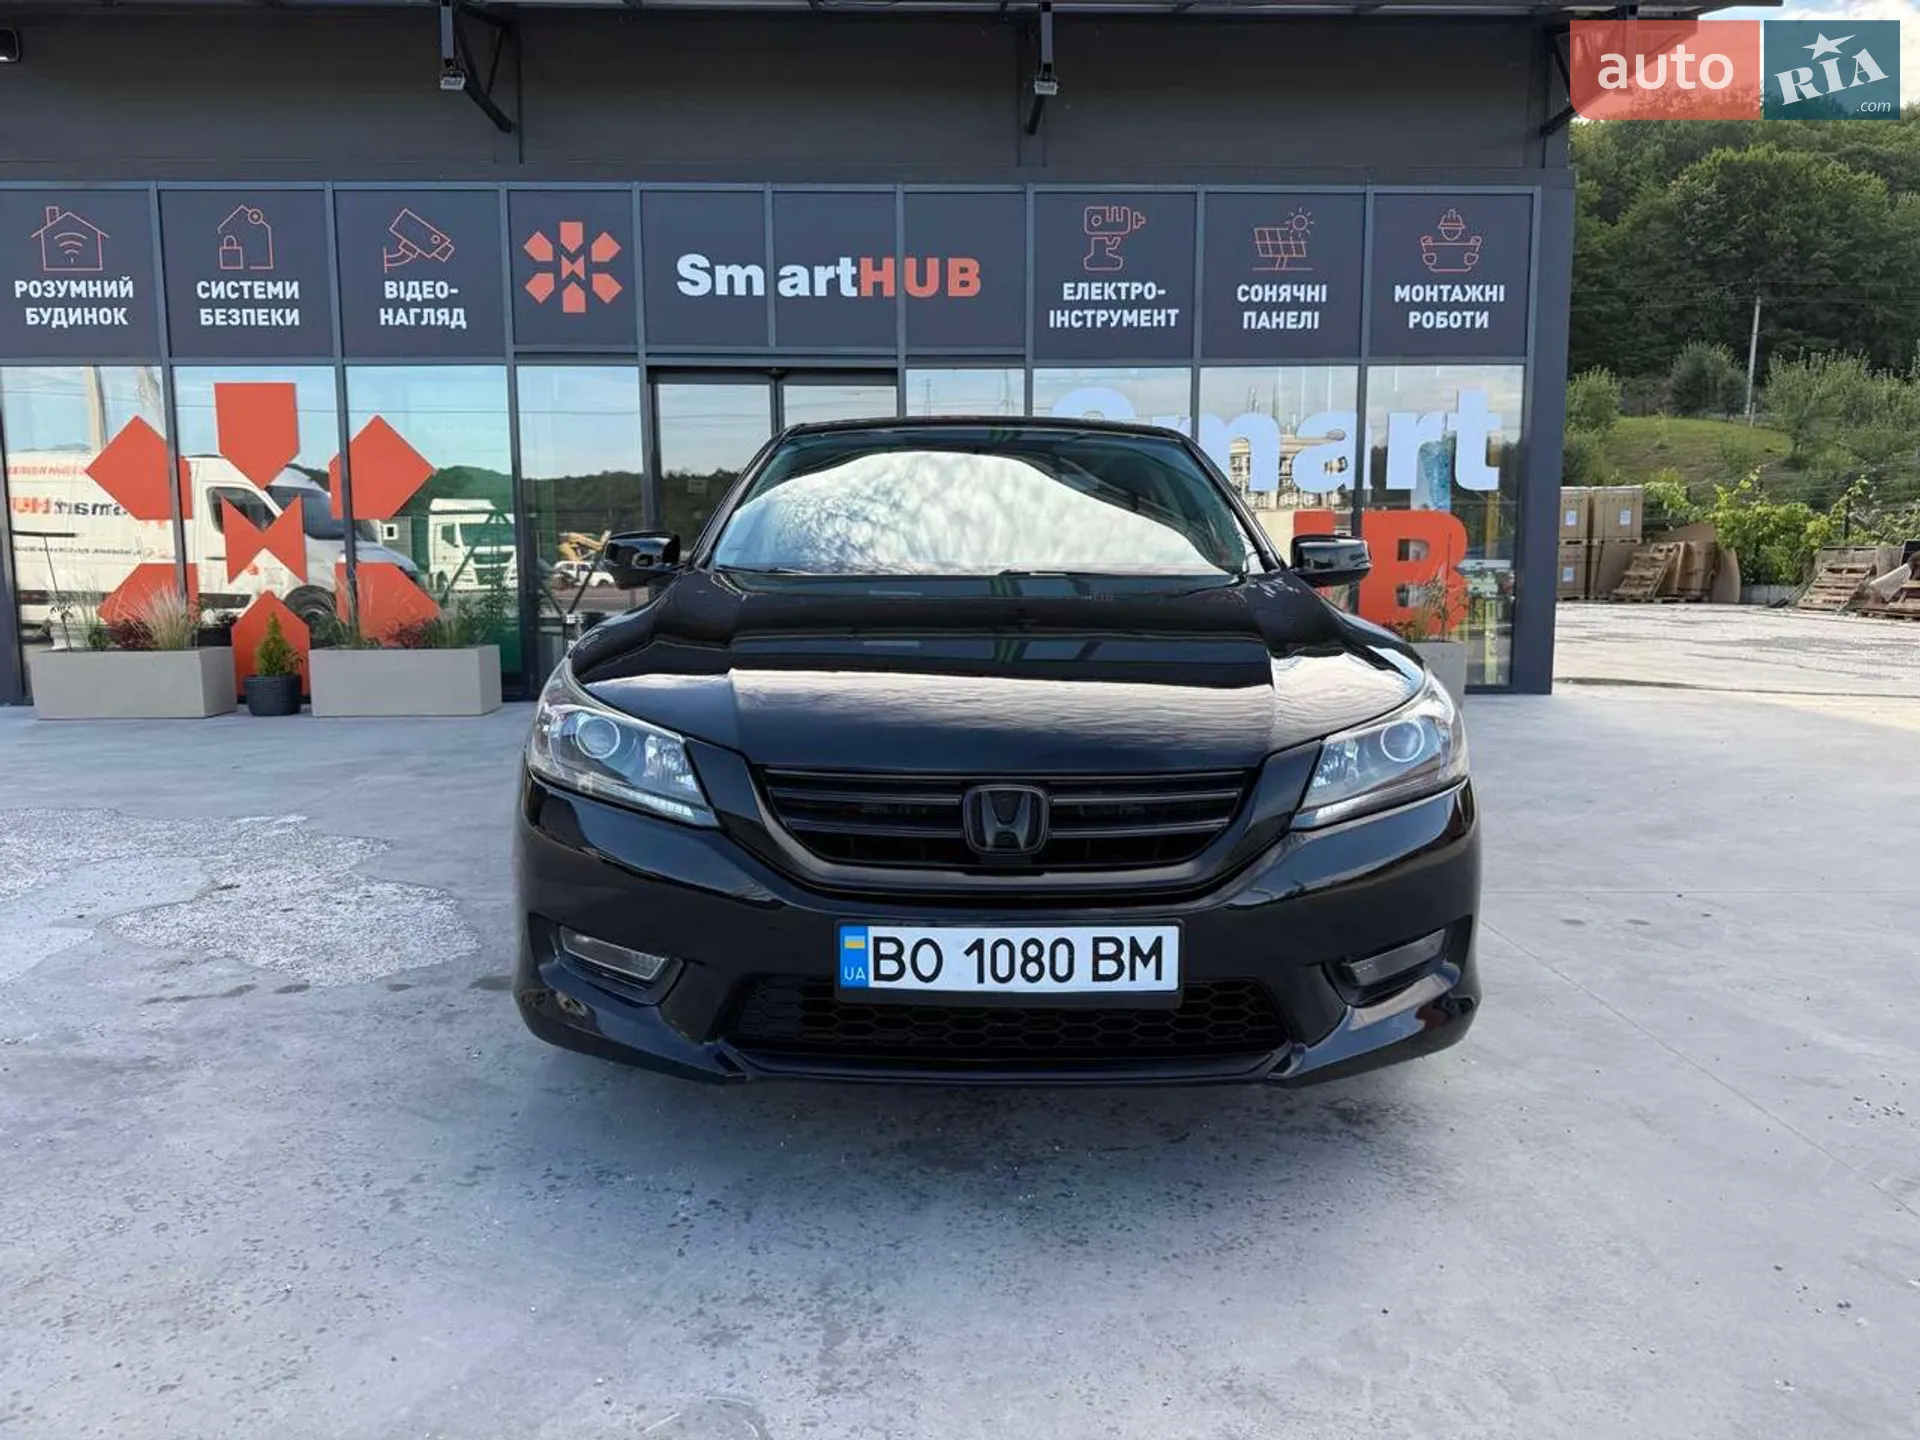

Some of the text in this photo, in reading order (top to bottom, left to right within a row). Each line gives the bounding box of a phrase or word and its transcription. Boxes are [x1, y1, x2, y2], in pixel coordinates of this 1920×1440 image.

[676, 252, 982, 298] SmartHUB
[14, 276, 134, 299] РОЗУМНИЙ
[196, 280, 300, 301] СИСТЕМИ
[383, 280, 459, 303] ВІДЕО-
[1062, 282, 1166, 301] ЕЛЕКТРО-
[1236, 284, 1327, 303] СОНЯЧНІ
[1394, 284, 1505, 303] МОНТАЖНІ
[25, 306, 129, 328] БУДИНОК
[199, 307, 301, 327] БЕЗПЕКИ
[379, 307, 467, 329] НАГЛЯД
[1049, 308, 1179, 328] ІНСТРУМЕНТ
[1242, 311, 1320, 330] ПАНЕЛІ
[1408, 311, 1489, 329] РОБОТИ
[872, 935, 1163, 984] BO 1080 BM
[843, 967, 867, 981] UA
